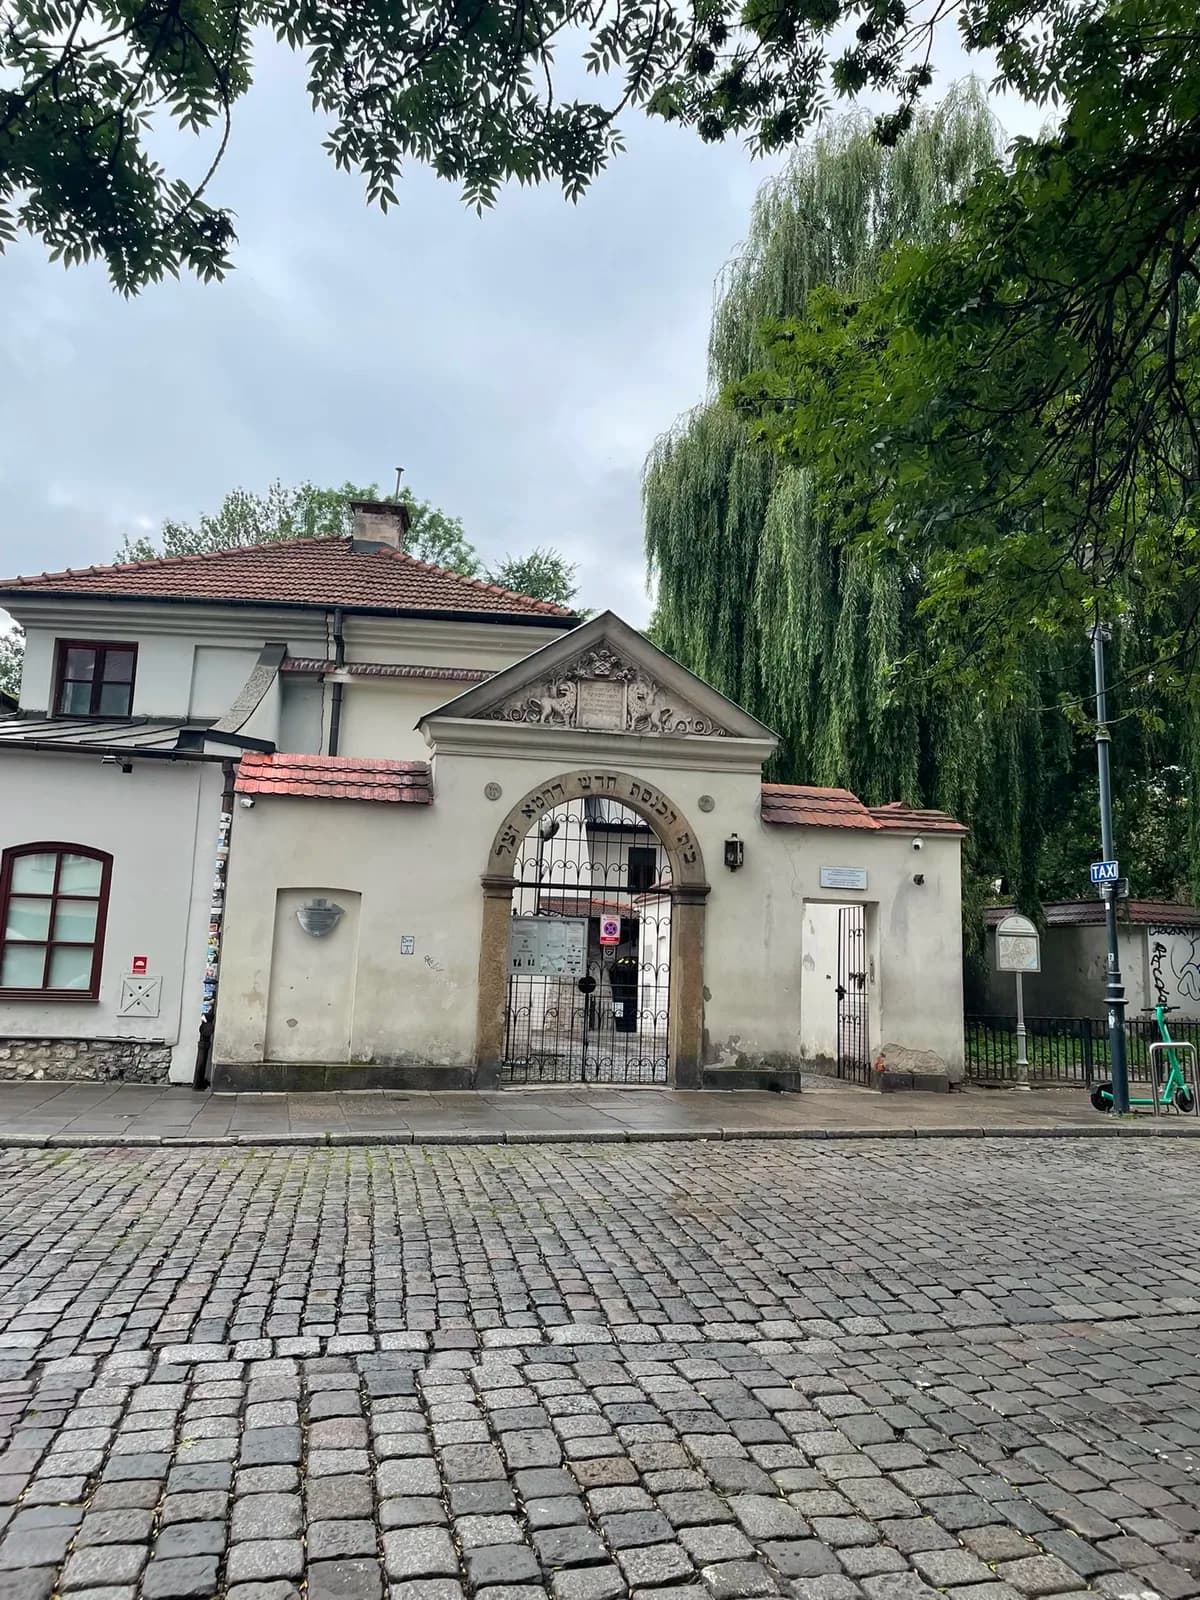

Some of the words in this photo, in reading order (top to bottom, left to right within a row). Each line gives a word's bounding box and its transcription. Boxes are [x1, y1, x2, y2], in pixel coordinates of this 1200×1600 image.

[577, 775, 617, 790] חדש
[629, 782, 677, 825] הכנסת
[677, 832, 697, 864] בית
[1092, 863, 1116, 880] TAXI
